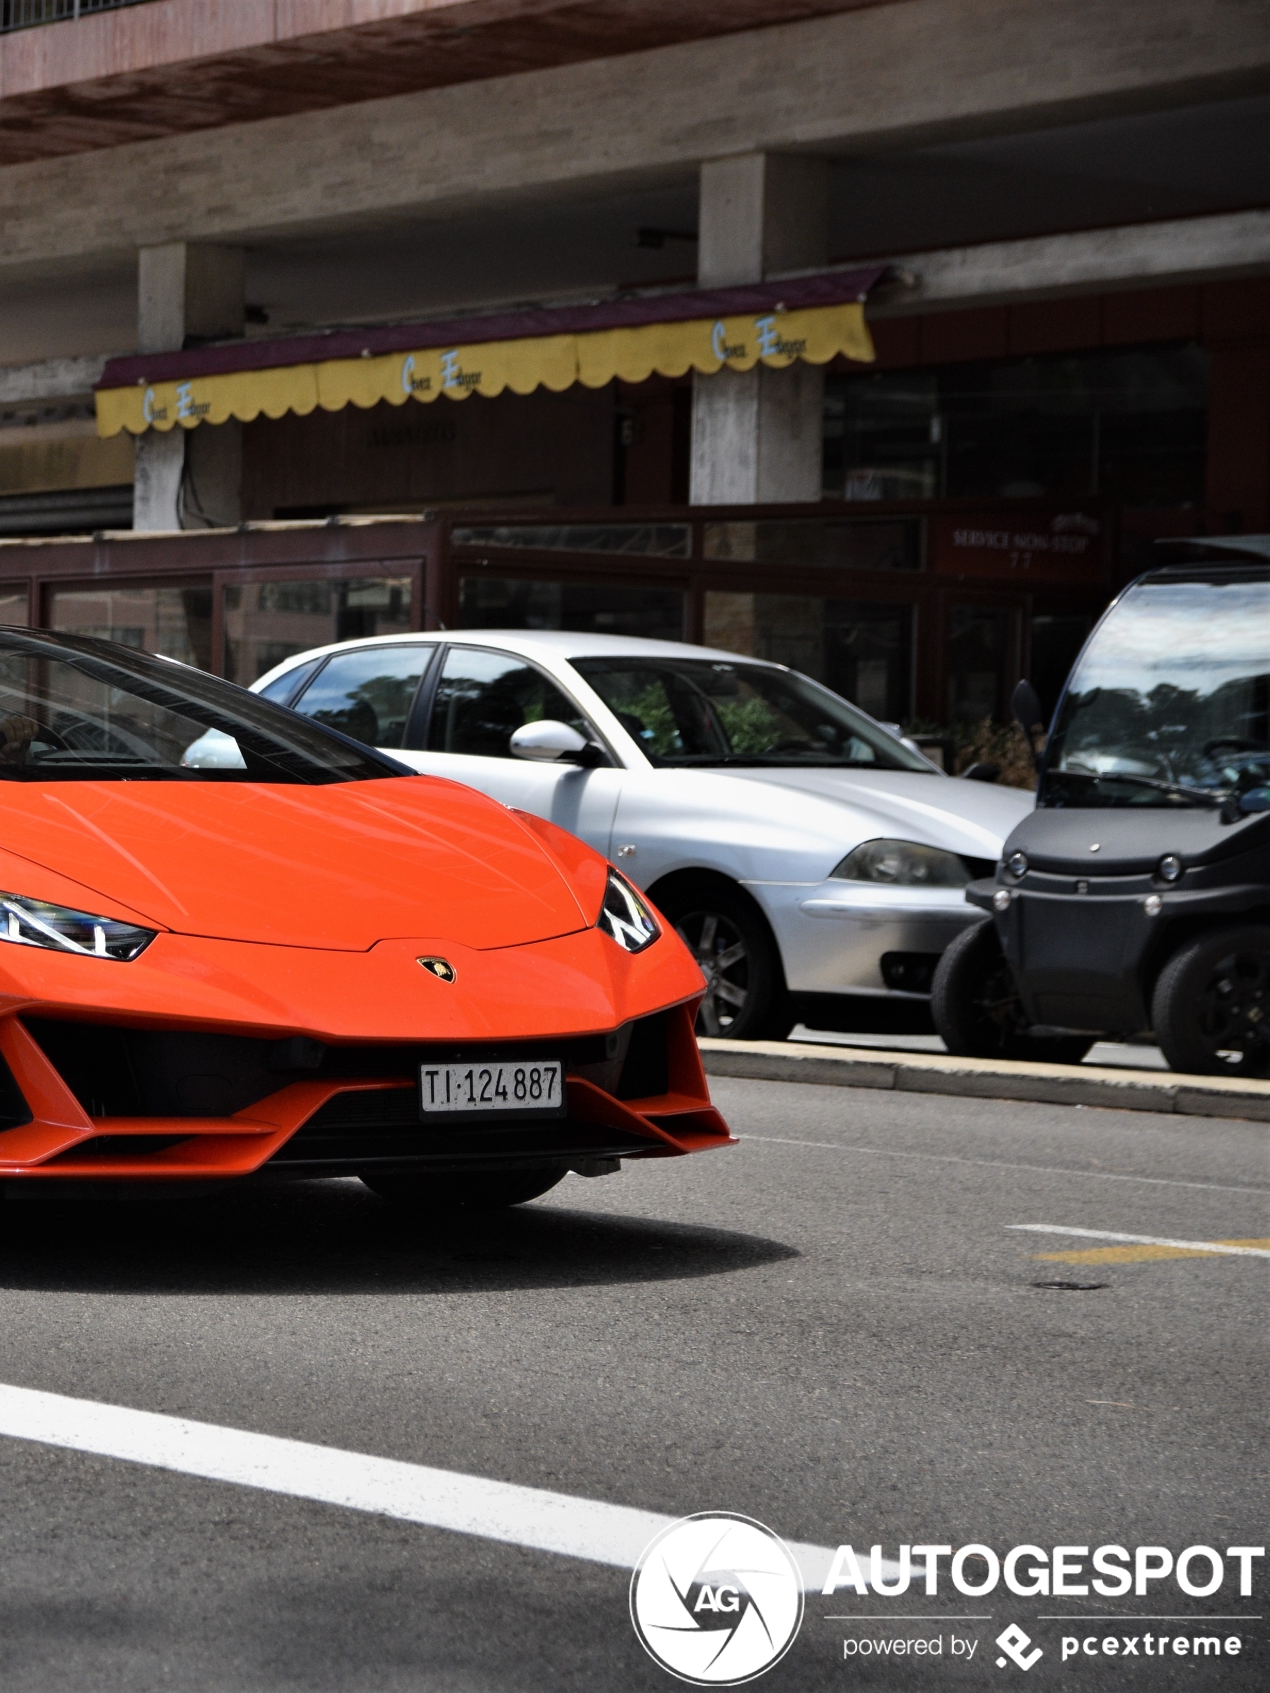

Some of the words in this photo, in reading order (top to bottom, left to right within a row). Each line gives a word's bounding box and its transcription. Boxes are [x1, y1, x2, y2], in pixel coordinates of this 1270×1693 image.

[755, 315, 808, 361] Edgar
[440, 350, 483, 391] Edgar
[176, 382, 212, 421] Edgar
[952, 529, 1011, 550] SERVICE
